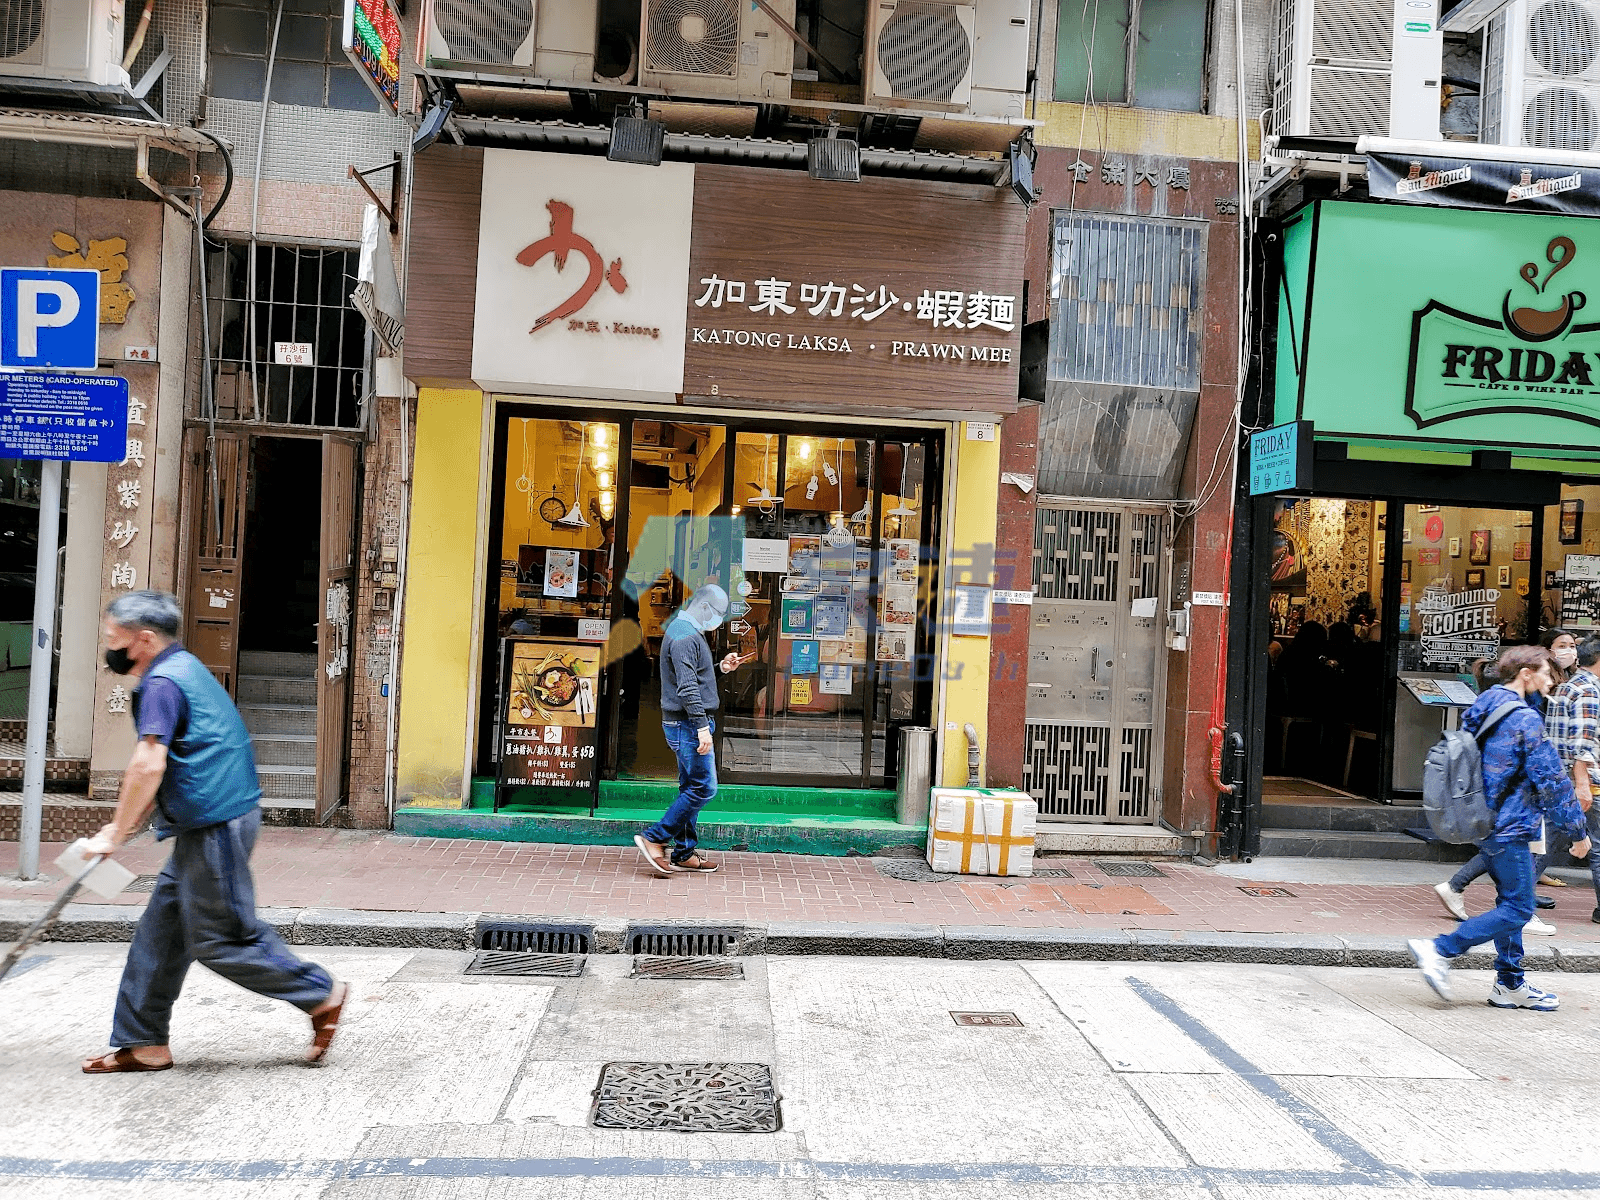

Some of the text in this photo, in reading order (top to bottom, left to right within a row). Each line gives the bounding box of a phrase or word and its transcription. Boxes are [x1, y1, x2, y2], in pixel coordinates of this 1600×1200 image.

[1423, 164, 1469, 189] Miguel
[1536, 171, 1580, 195] Miguel
[17, 279, 81, 358] P
[612, 322, 660, 339] Katong
[692, 328, 1012, 363] KATONG LAKSA PRAWN MEE
[1441, 344, 1600, 386] FRIDA
[46, 377, 118, 387] (CARD-OPERATED)
[1479, 382, 1509, 391] CAFE
[1525, 385, 1556, 393] WINE
[1560, 387, 1584, 395] BAR
[977, 430, 984, 440] 8
[1254, 426, 1294, 457] FRIDAY
[1432, 608, 1493, 635] COFFEE
[580, 745, 595, 759] $58
